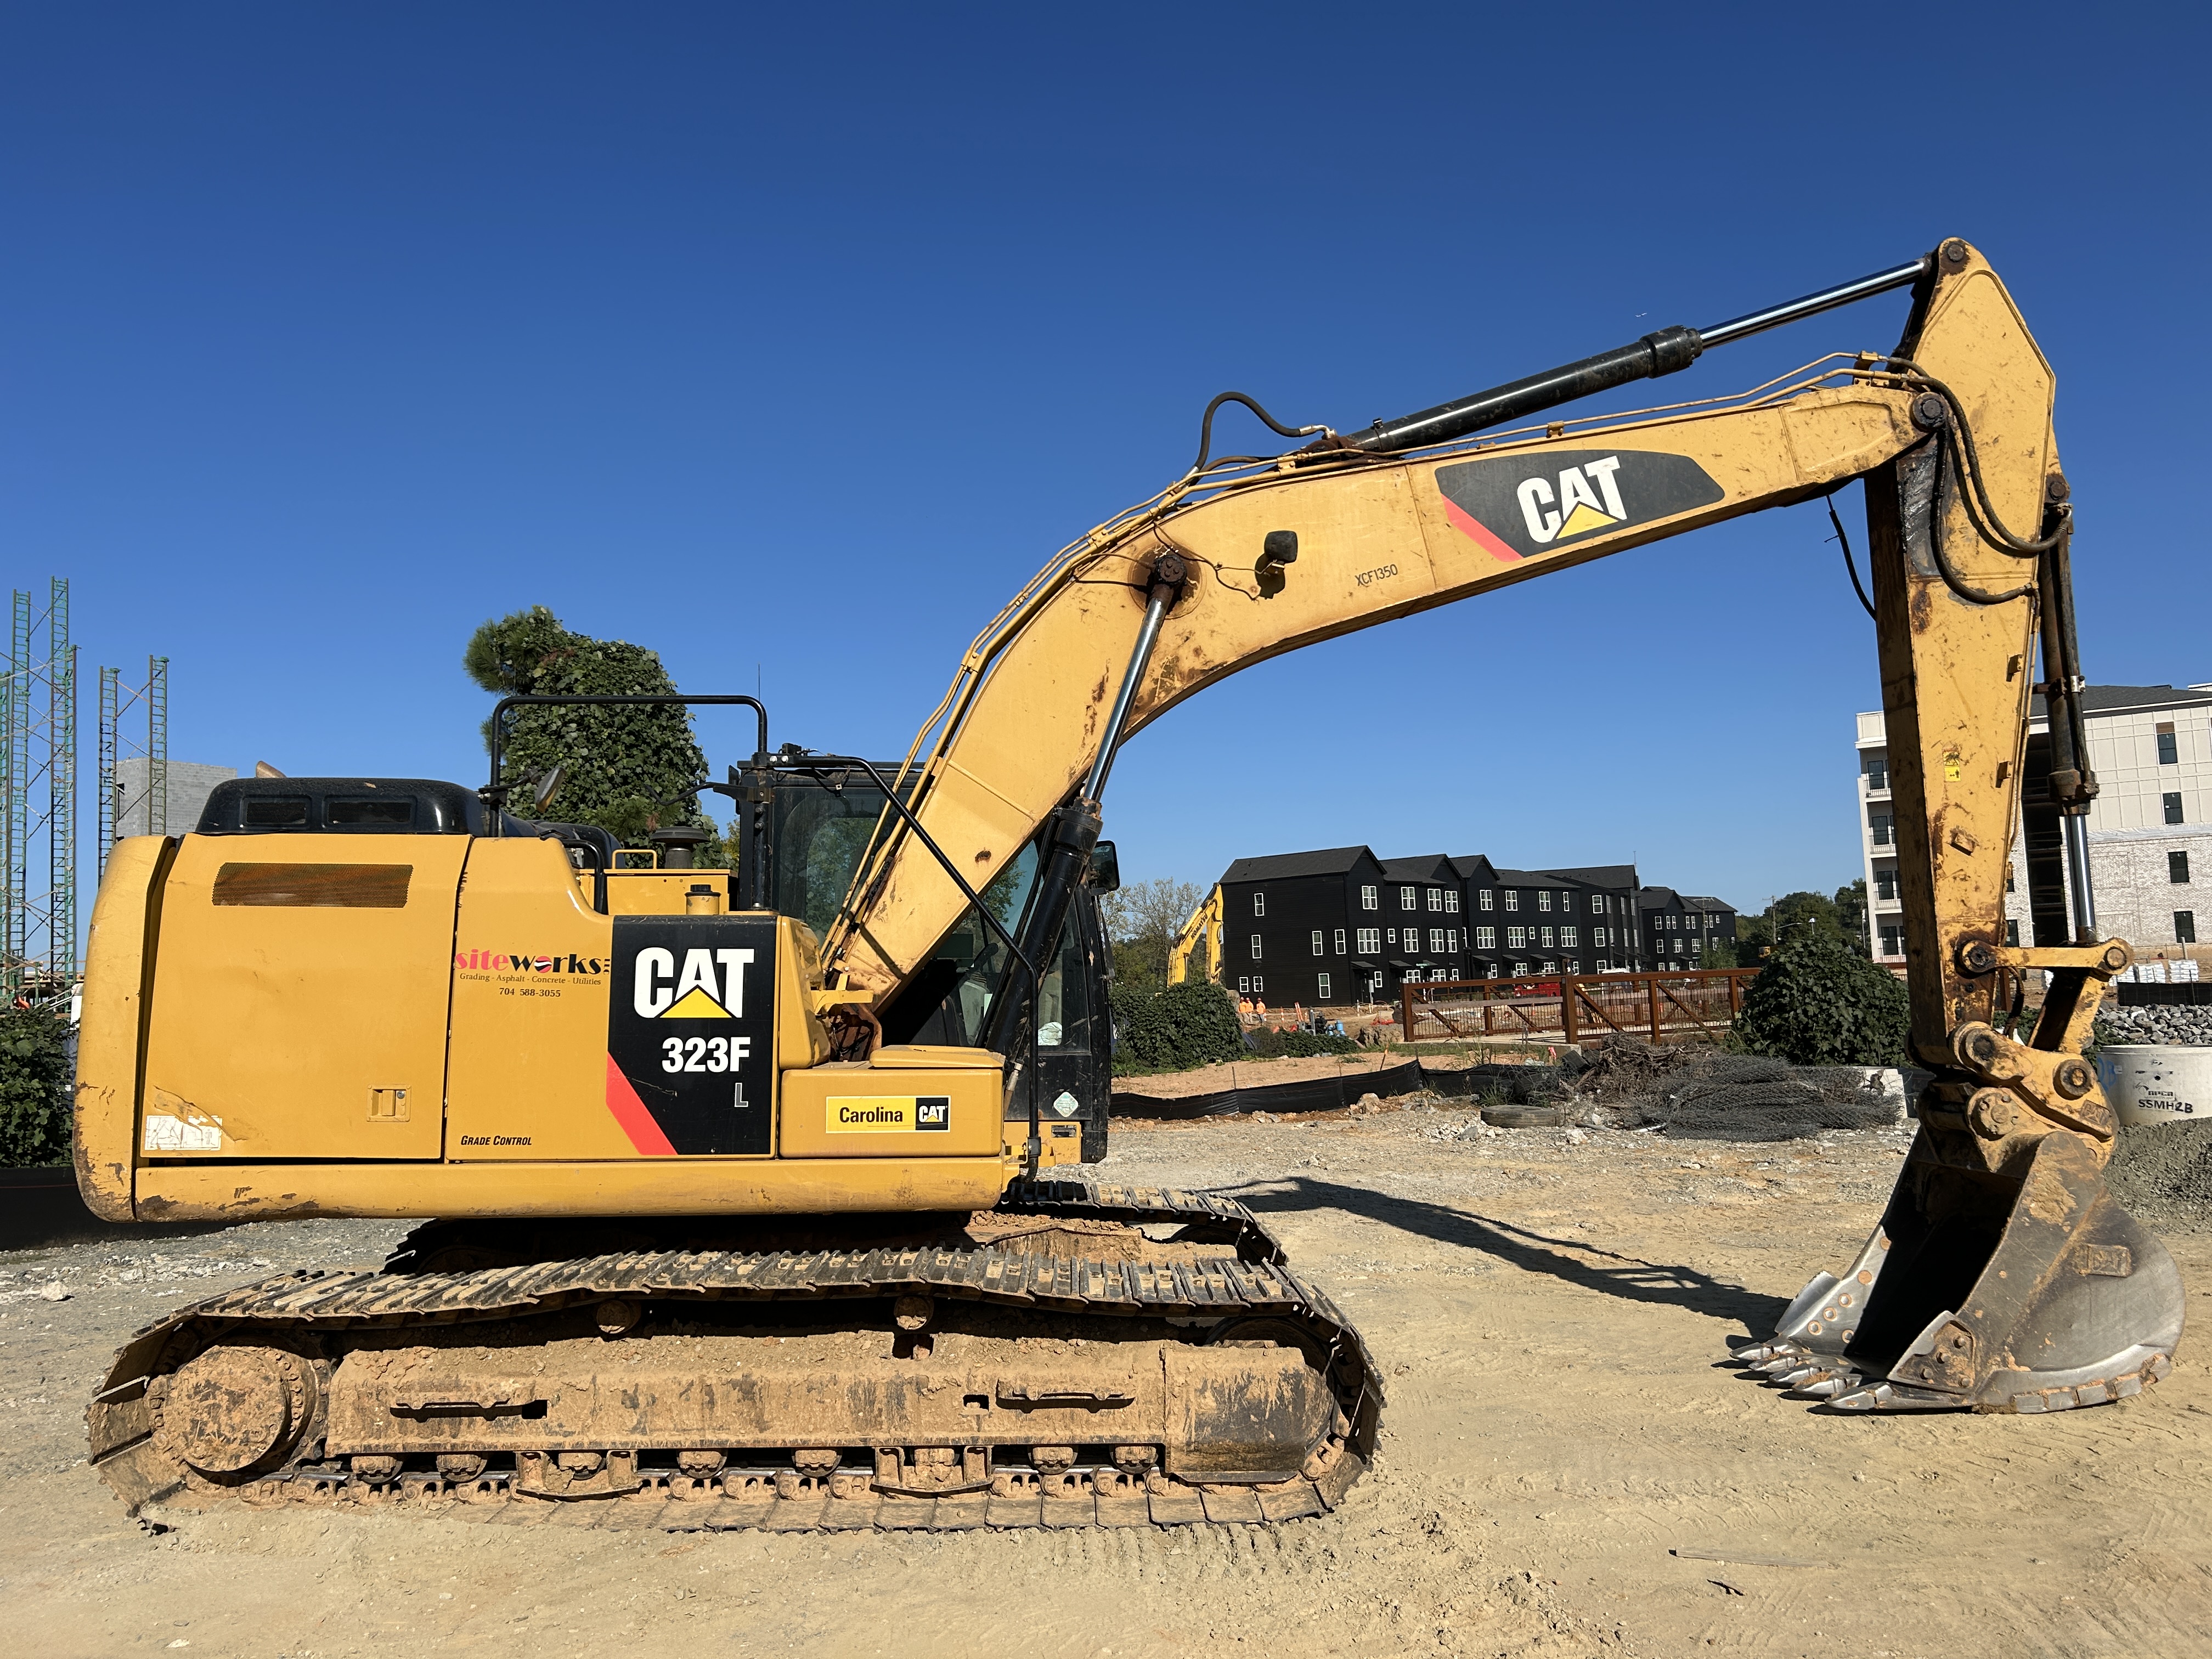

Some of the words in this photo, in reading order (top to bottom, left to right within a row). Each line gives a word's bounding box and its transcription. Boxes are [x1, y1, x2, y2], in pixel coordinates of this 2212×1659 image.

[1517, 455, 1627, 543] CAT
[1355, 564, 1398, 587] XCF1350
[1190, 911, 1208, 940] KOMATSU
[455, 949, 601, 975] siteworks
[460, 973, 490, 983] Grading
[496, 974, 525, 984] Asphalt
[532, 975, 566, 984] Concrete
[573, 977, 601, 985] Utilities
[634, 947, 754, 1018] CAT
[499, 988, 515, 996] 704
[520, 989, 561, 998] 588-3055
[662, 1036, 751, 1073] 323F
[734, 1082, 749, 1108] L
[839, 1106, 903, 1123] Carolina
[918, 1105, 946, 1123] CAT
[460, 1135, 491, 1146] GRADE
[493, 1135, 532, 1146] CONTROL
